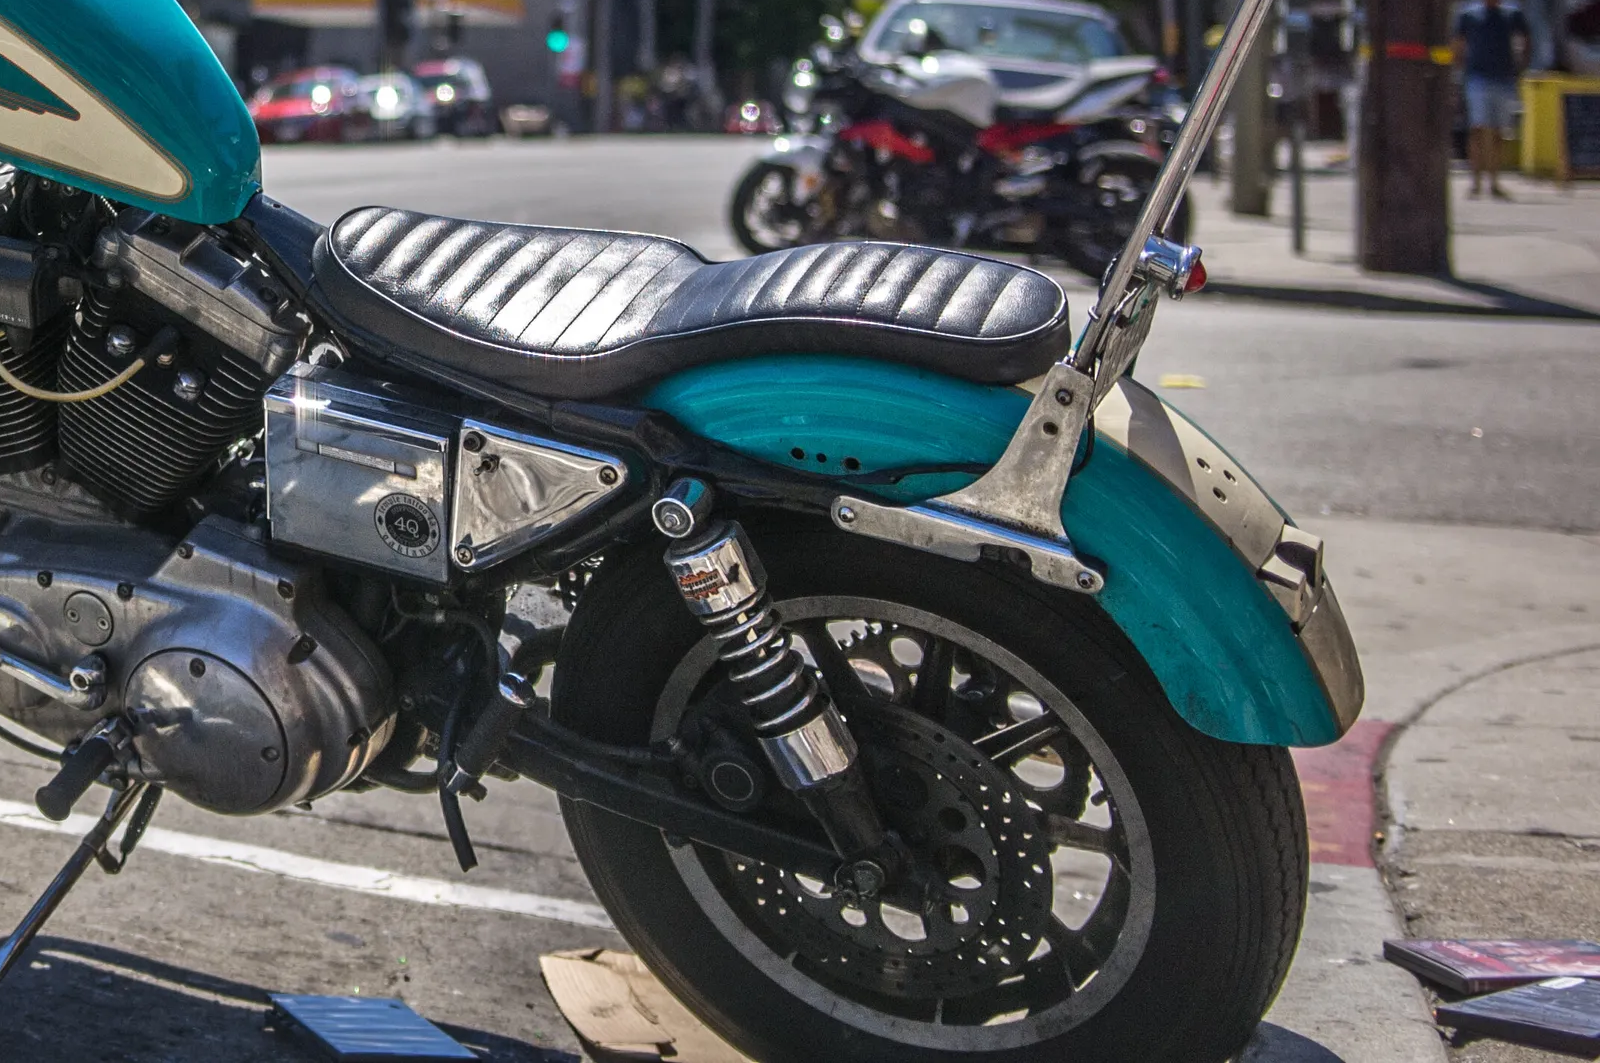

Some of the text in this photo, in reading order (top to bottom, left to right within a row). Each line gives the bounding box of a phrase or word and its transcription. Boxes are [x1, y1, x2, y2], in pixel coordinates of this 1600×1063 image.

[378, 496, 400, 514] temple
[403, 496, 428, 515] tattoo
[394, 517, 419, 538] 4Q
[382, 534, 432, 557] oakland
